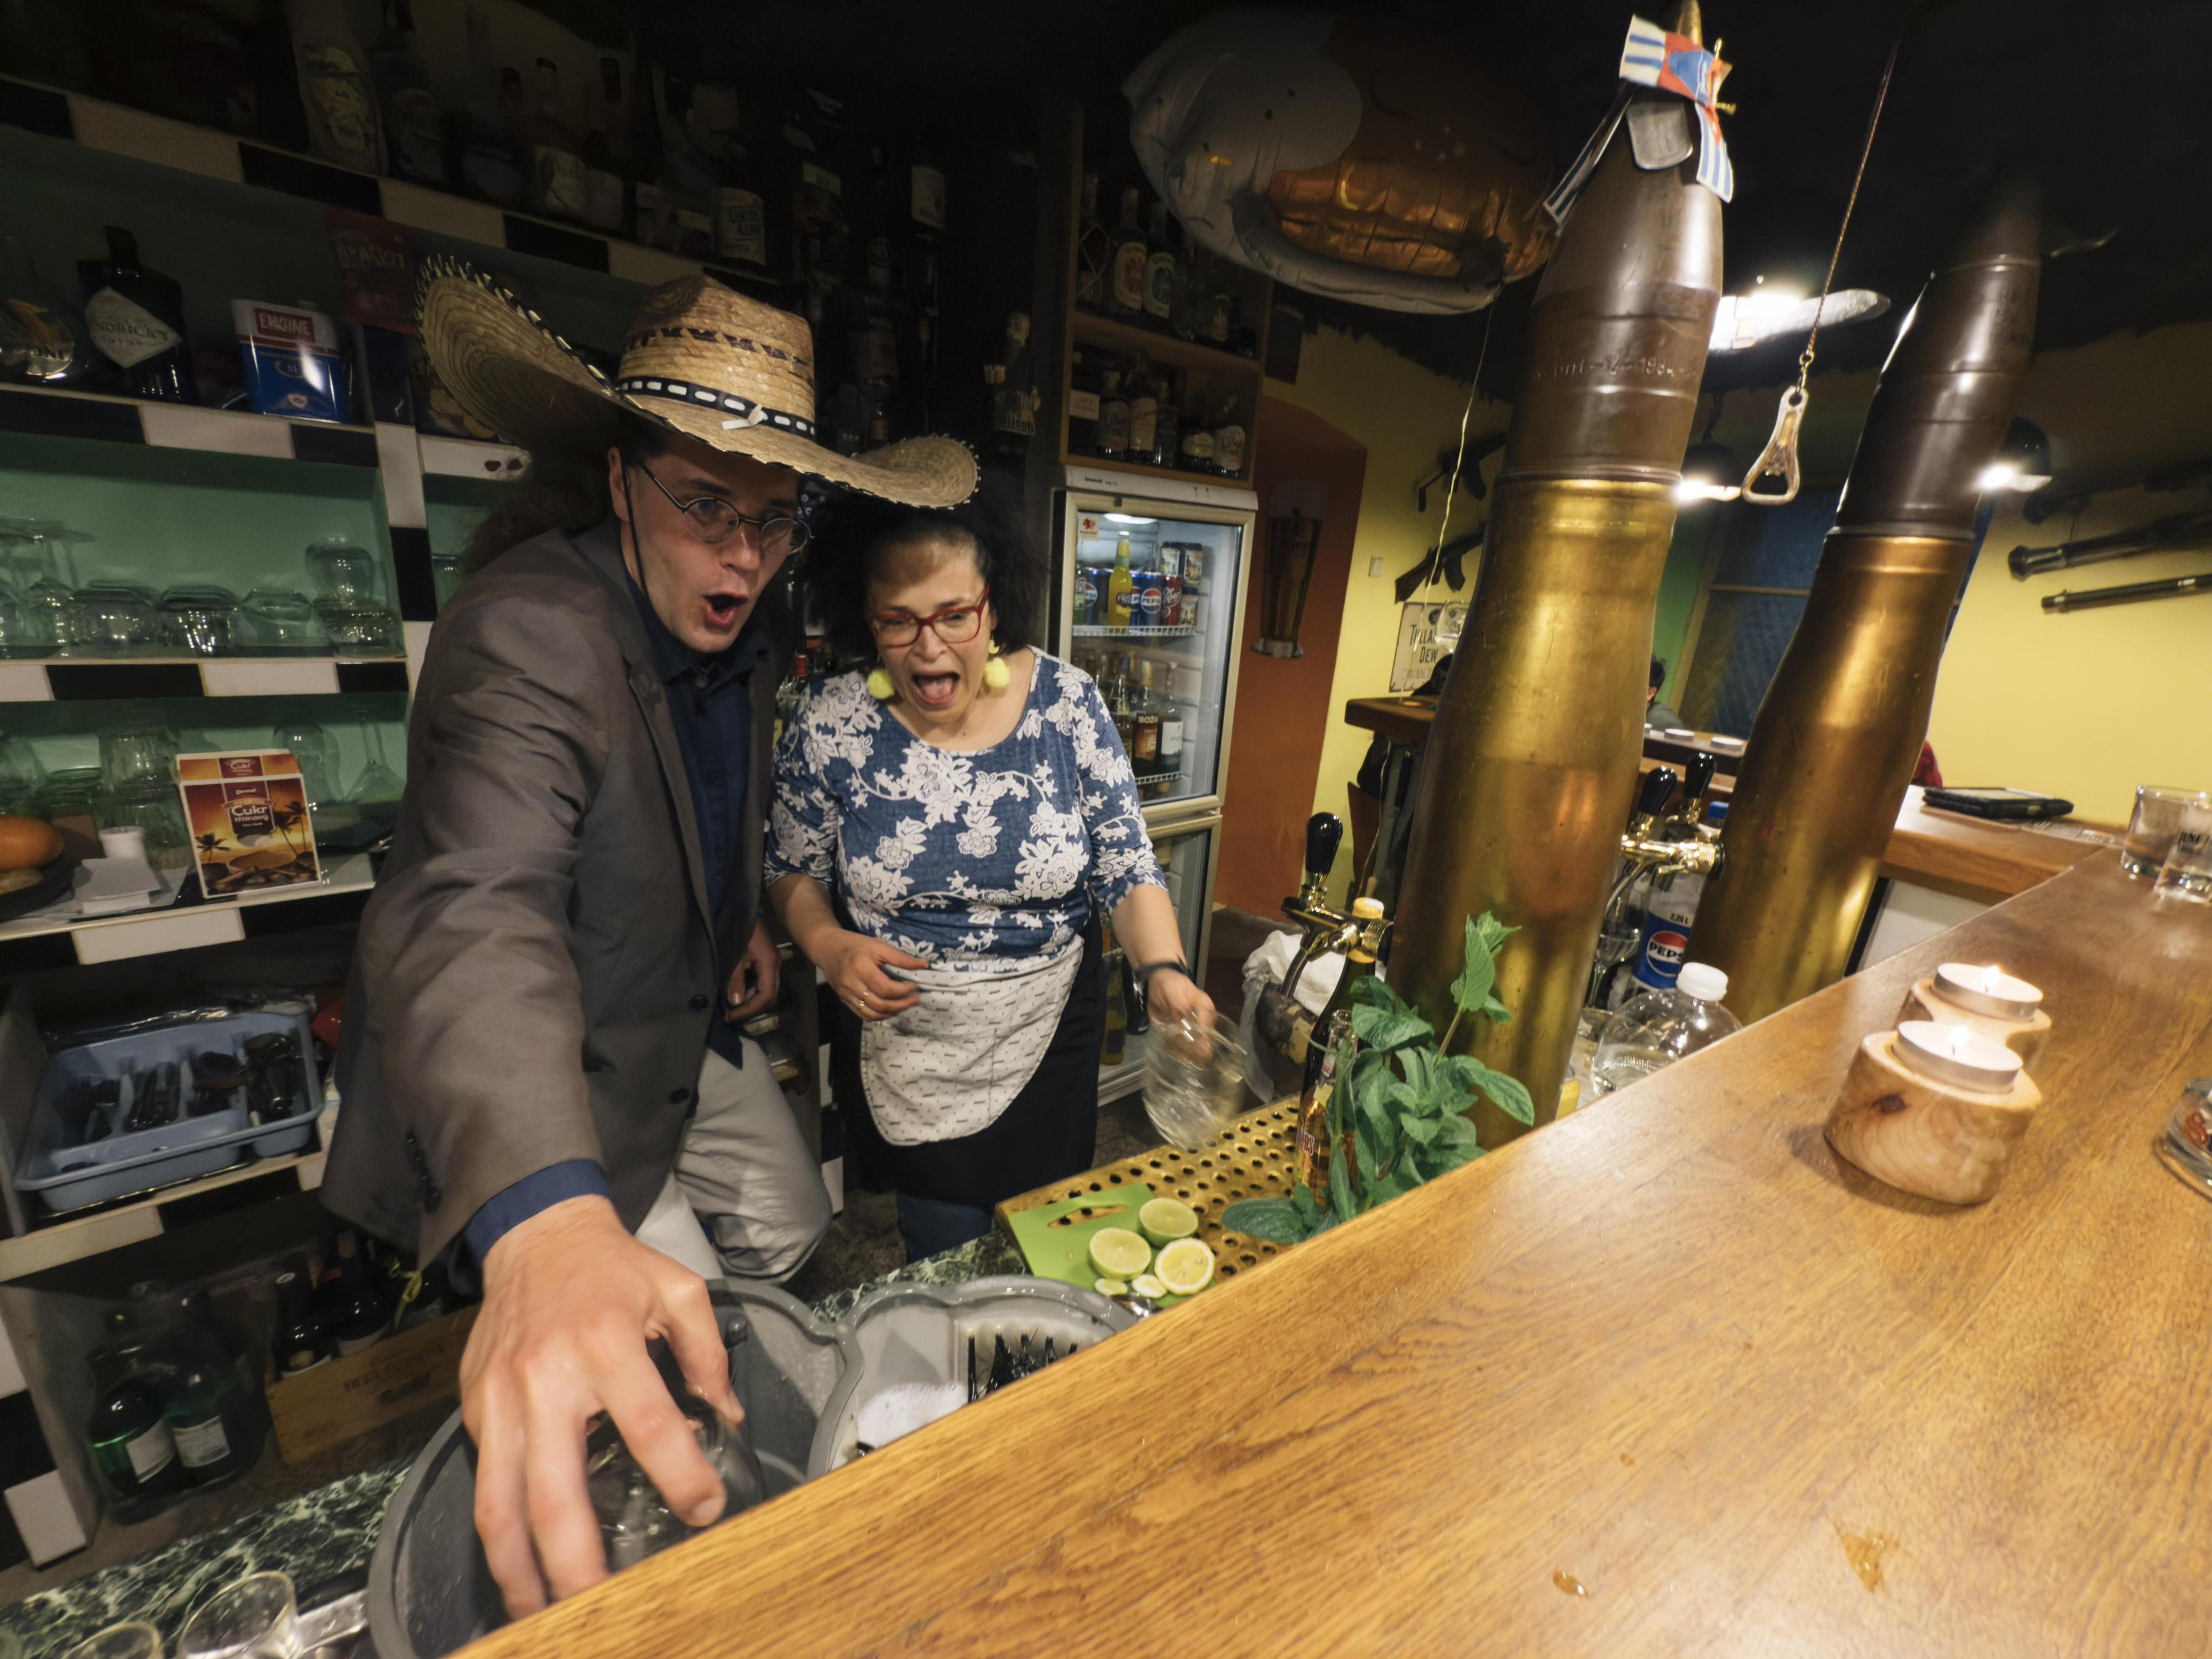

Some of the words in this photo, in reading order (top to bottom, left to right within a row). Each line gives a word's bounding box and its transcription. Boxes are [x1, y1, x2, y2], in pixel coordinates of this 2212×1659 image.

[1419, 646, 1438, 664] DEW
[232, 805, 268, 816] Cukr
[1649, 942, 1683, 961] PEPS
